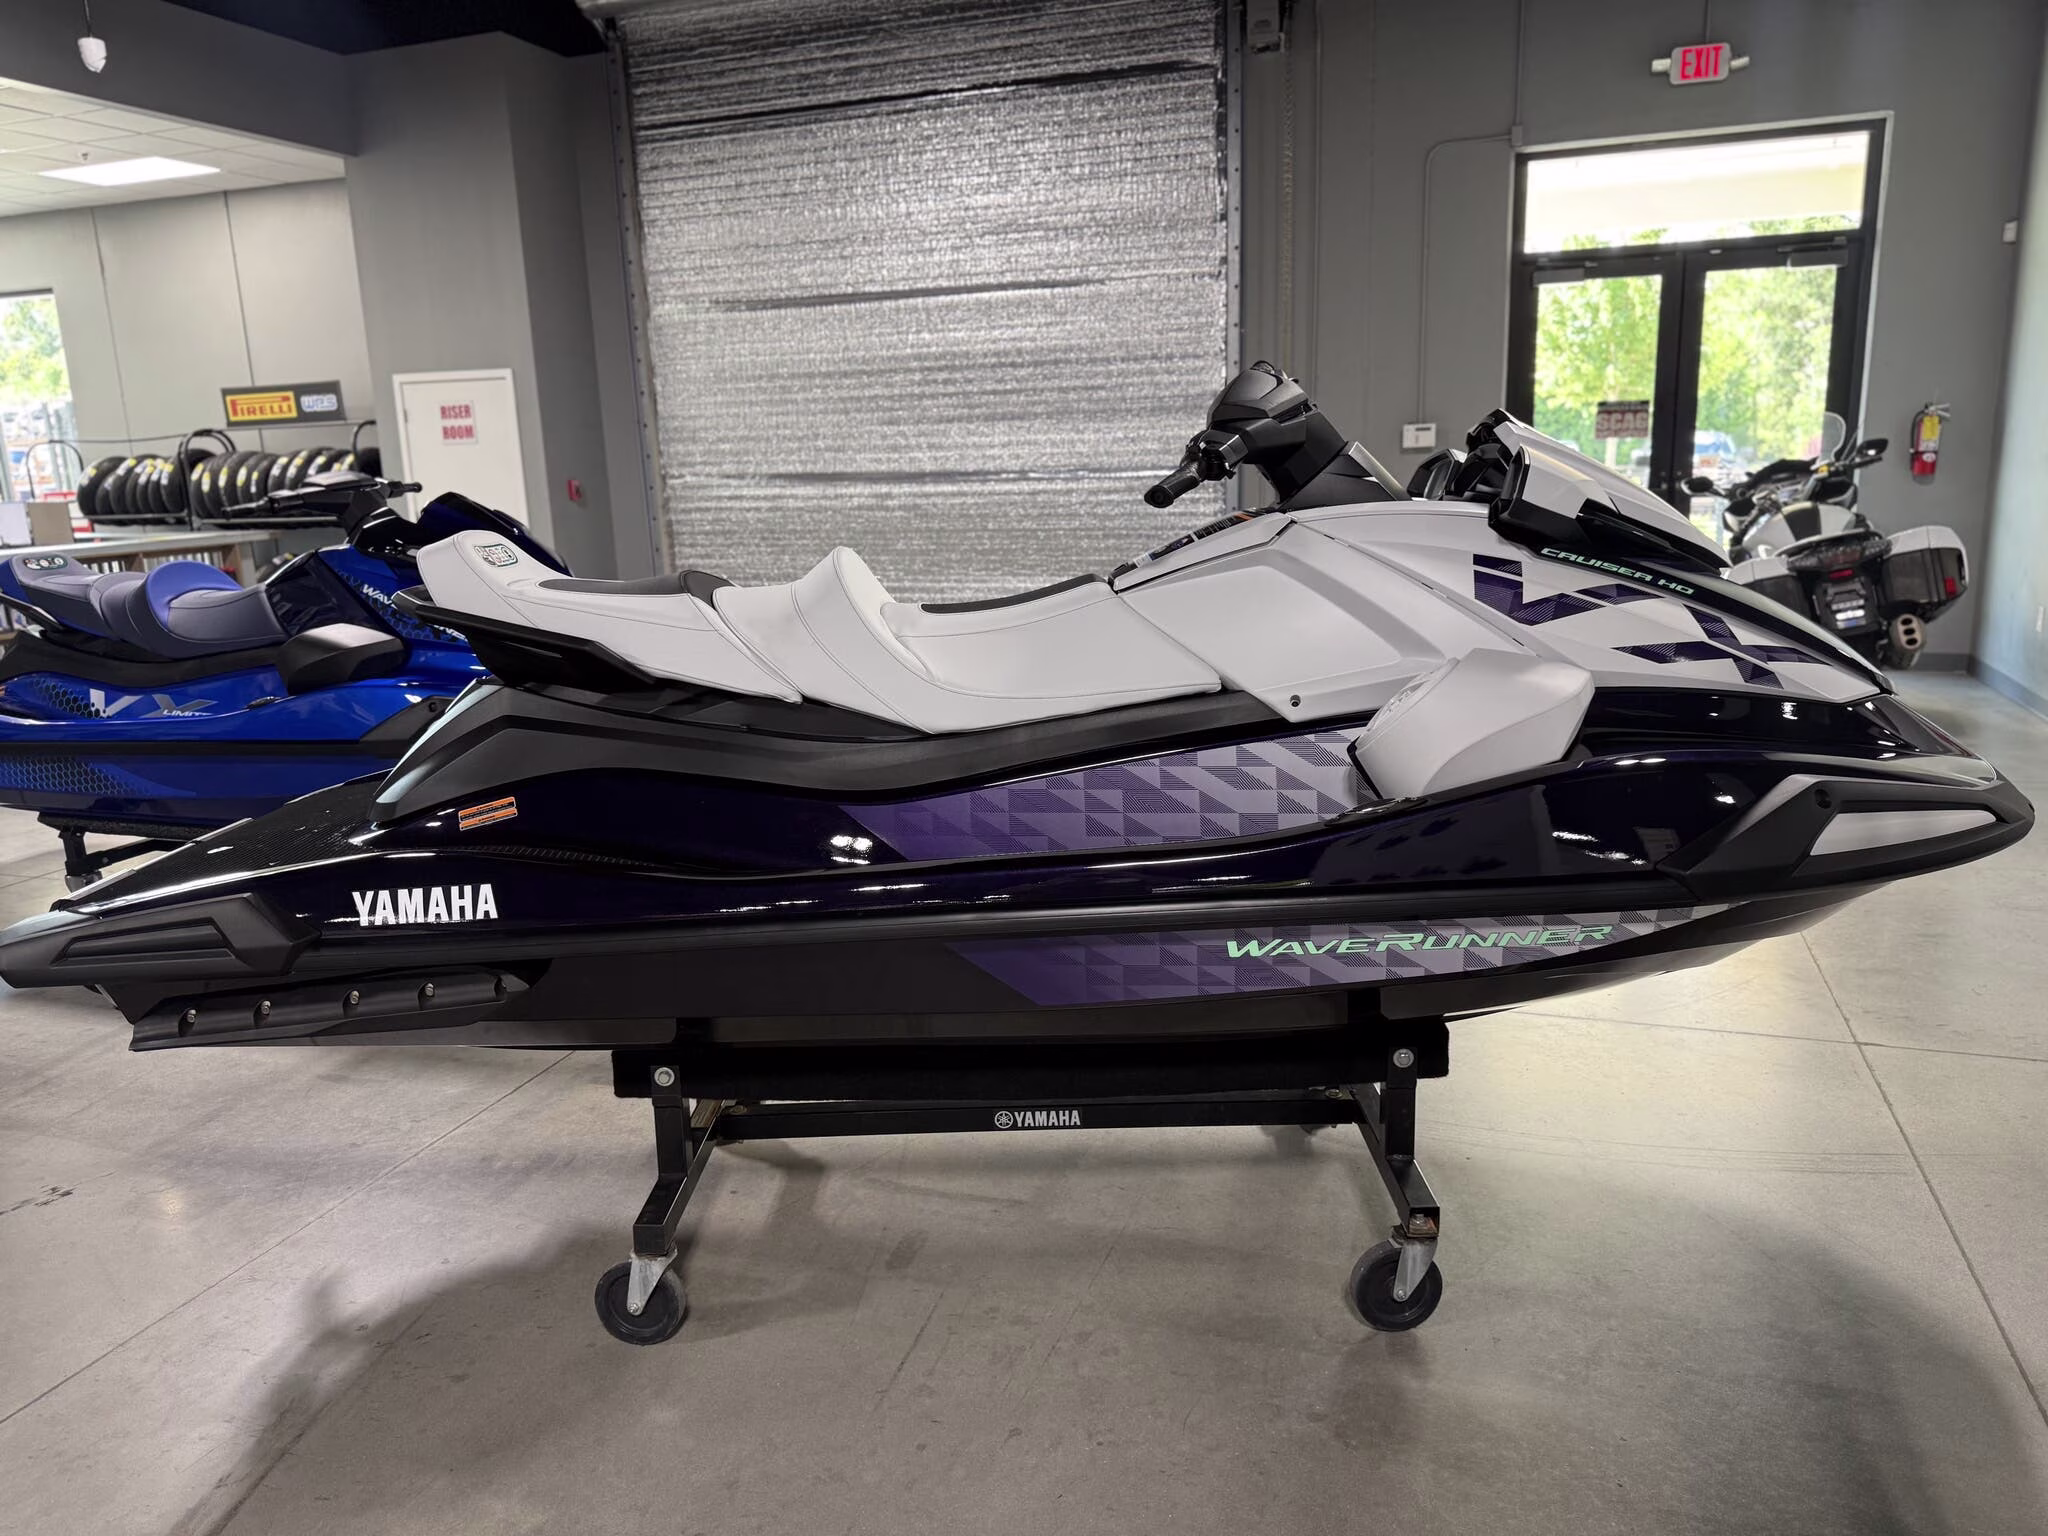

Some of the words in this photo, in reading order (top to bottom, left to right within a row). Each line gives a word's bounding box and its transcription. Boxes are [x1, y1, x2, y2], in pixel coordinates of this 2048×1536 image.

[1681, 45, 1723, 80] EXIT
[229, 394, 293, 417] PIRELLI
[440, 405, 472, 420] RISER
[1596, 411, 1649, 430] SCAG
[442, 425, 474, 440] ROOM
[1540, 547, 1653, 582] CRUISER
[352, 883, 498, 926] YAMAHA
[1226, 926, 1613, 958] WAVERUNNER
[1014, 1110, 1080, 1127] YAMAHA
